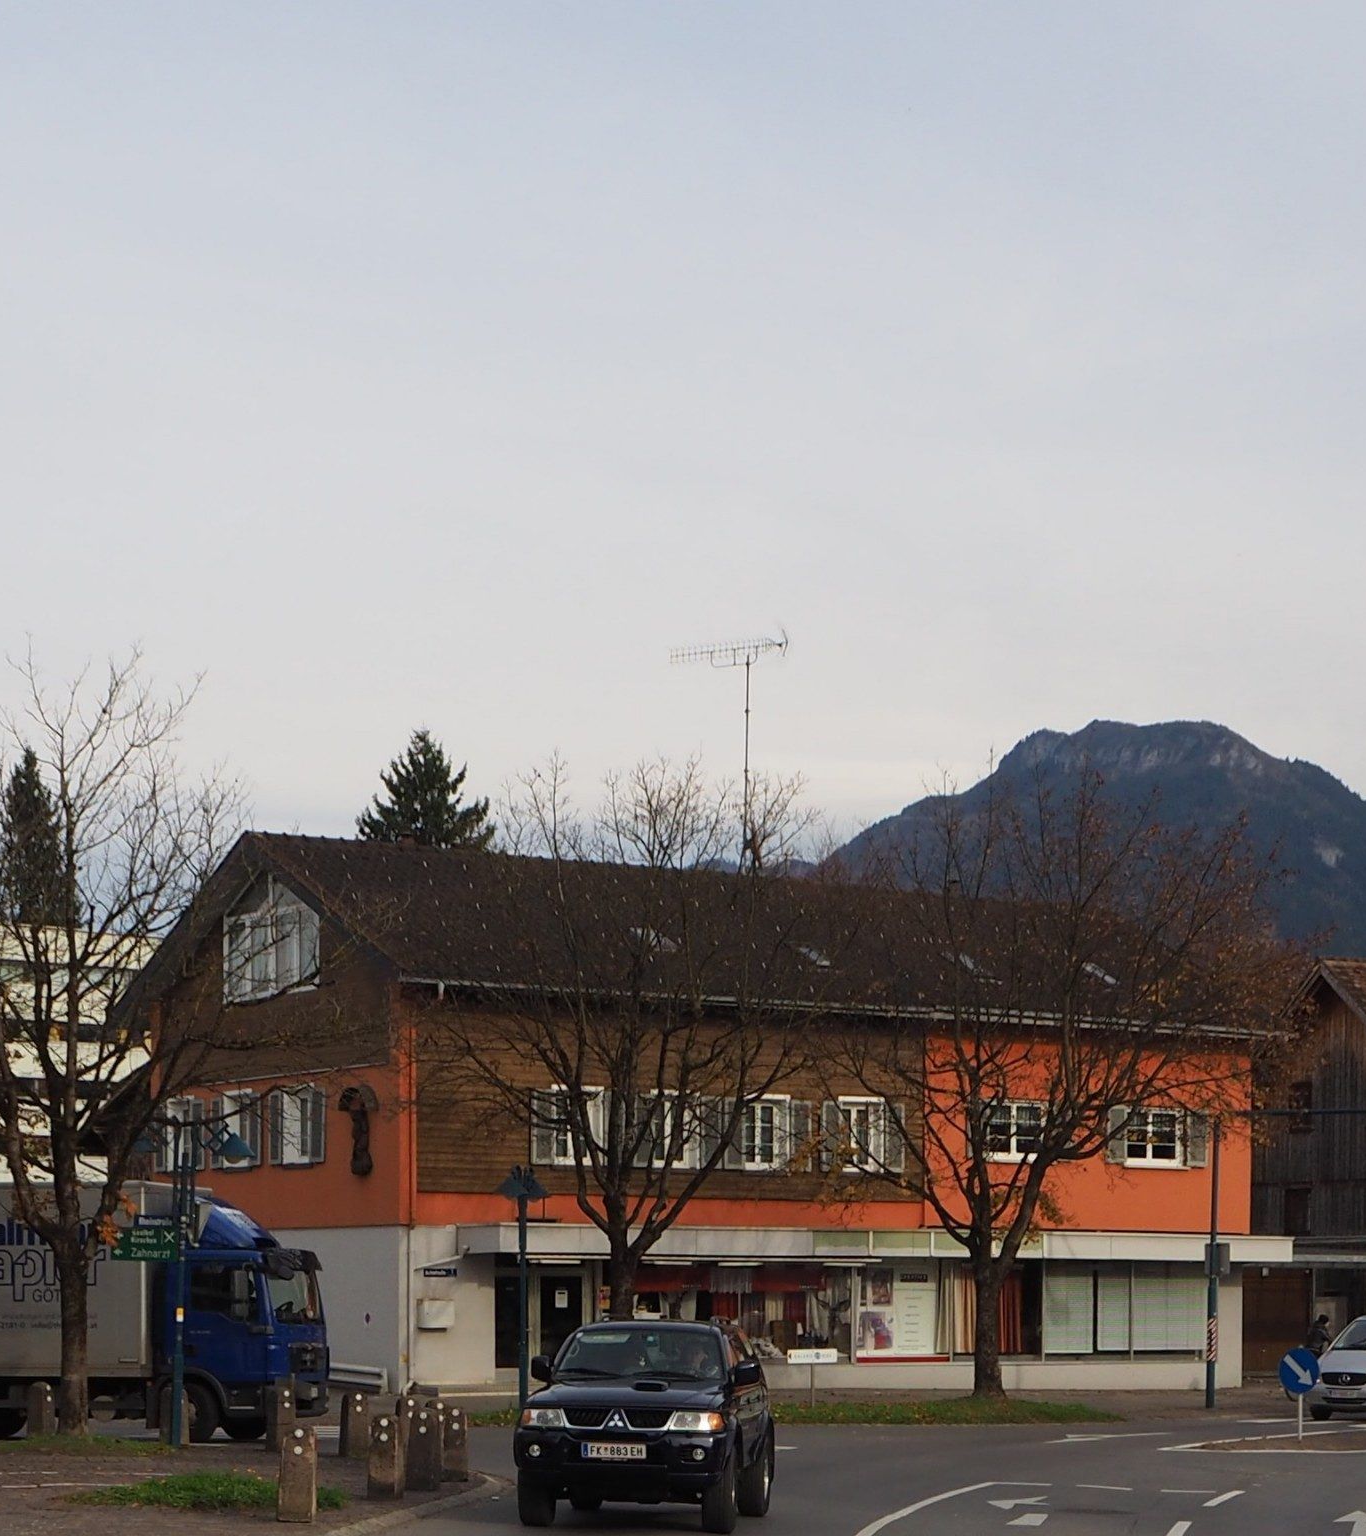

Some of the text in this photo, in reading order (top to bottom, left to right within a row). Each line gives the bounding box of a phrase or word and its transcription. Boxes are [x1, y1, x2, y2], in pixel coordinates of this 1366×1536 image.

[131, 1247, 170, 1259] Zahnarzt
[32, 1287, 62, 1303] GÖT
[590, 1446, 602, 1455] FK
